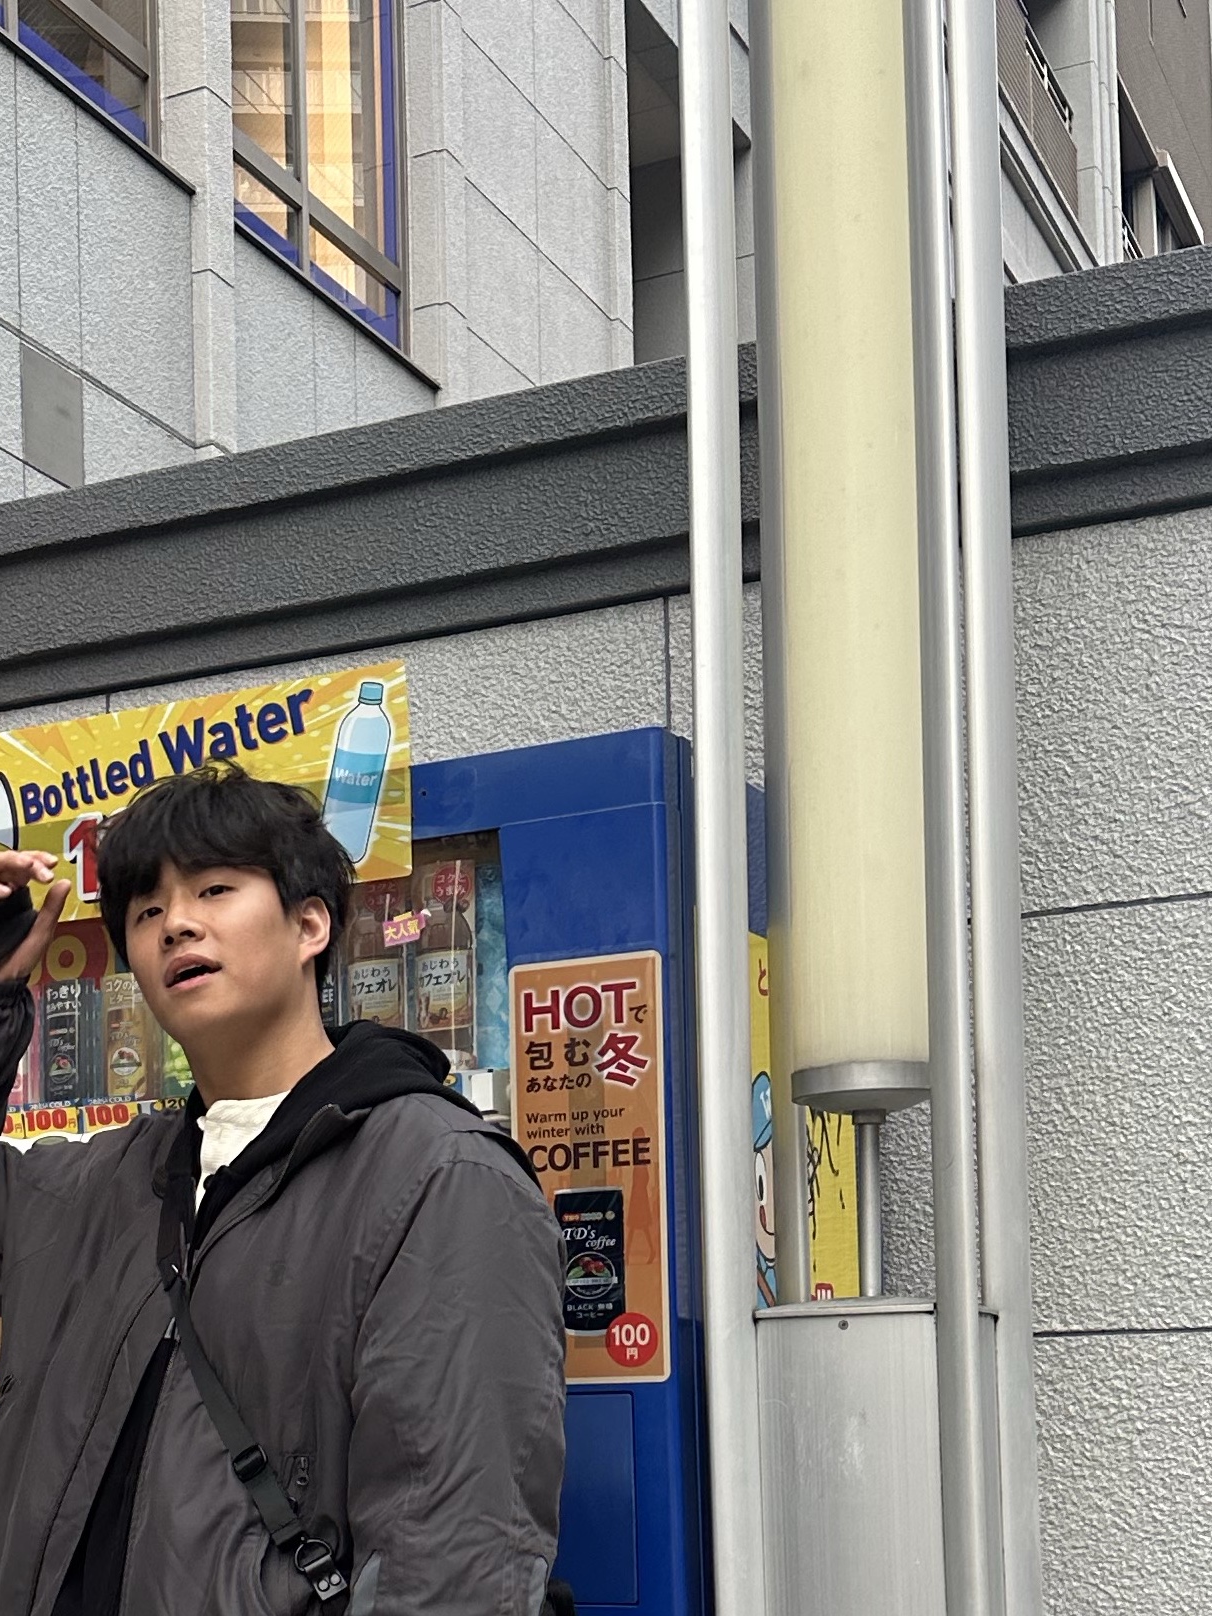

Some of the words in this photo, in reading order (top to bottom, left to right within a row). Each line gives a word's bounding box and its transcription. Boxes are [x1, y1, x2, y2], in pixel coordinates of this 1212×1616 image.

[21, 738, 155, 824] Bottled
[158, 688, 314, 777] Water
[333, 766, 378, 789] Water
[385, 920, 420, 940] 大人気
[353, 966, 390, 980] あじわう
[421, 958, 459, 970] あじわう
[46, 984, 81, 1001] すっきり
[523, 981, 637, 1033] HOT
[596, 1032, 648, 1086] 冬
[526, 1072, 591, 1093] あなたの
[526, 1111, 567, 1125] Warm
[572, 1110, 588, 1127] up
[593, 1106, 624, 1122] your
[527, 1126, 570, 1139] winter
[574, 1123, 604, 1136] with
[529, 1138, 651, 1172] COFFEE
[586, 1236, 616, 1250] coffee
[567, 1303, 594, 1311] BLACK
[611, 1324, 650, 1346] 100
[626, 1348, 638, 1360] 円
